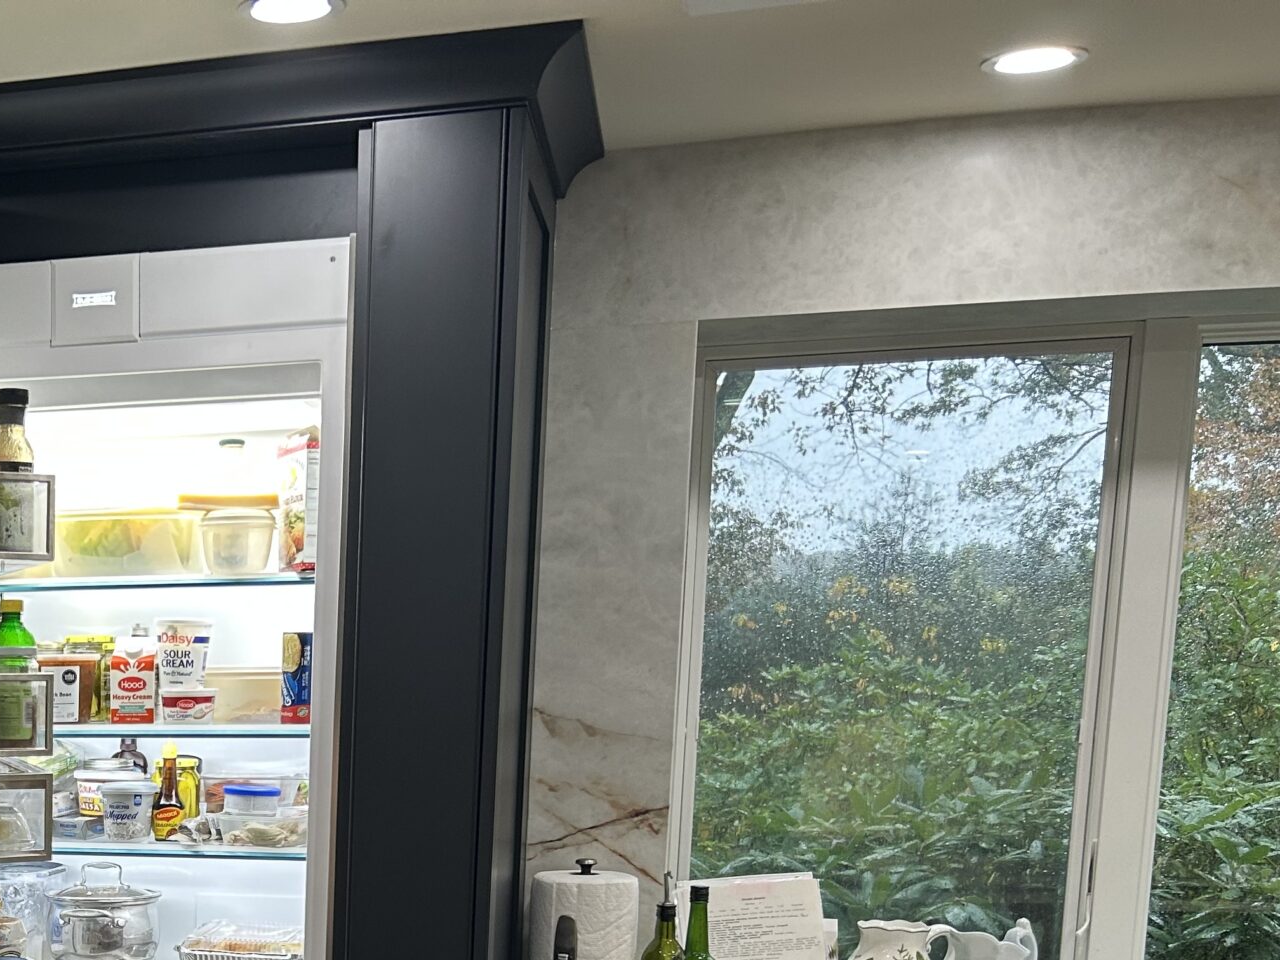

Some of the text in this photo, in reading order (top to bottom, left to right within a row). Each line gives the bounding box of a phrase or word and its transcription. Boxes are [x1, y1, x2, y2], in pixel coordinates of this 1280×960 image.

[161, 632, 192, 646] Daisy
[163, 649, 191, 659] SOUR
[161, 658, 194, 668] CREAM
[120, 680, 144, 689] Hood
